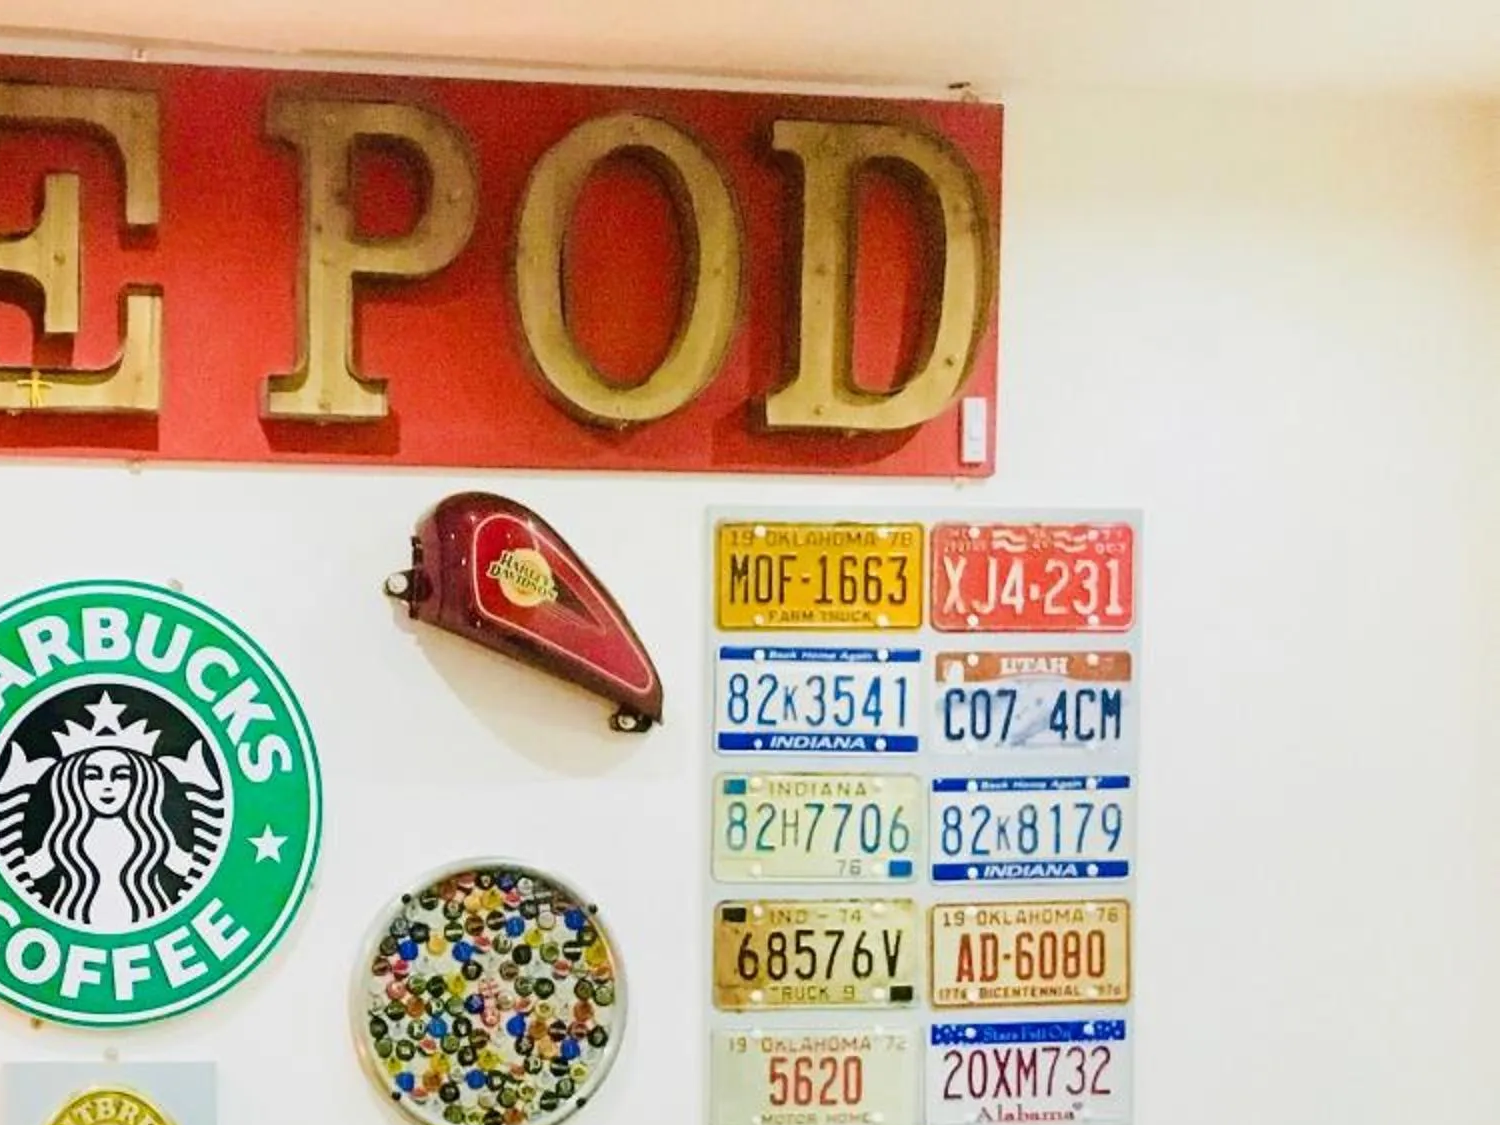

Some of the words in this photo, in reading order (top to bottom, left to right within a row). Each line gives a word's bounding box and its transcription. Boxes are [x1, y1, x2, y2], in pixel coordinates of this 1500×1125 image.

[259, 87, 991, 432] POD
[730, 530, 753, 547] 19
[766, 530, 876, 546] OKLAHOMA
[730, 554, 908, 606] MOF-1663
[769, 611, 814, 623] FARM
[821, 610, 871, 622] TRUCK
[1001, 656, 1069, 674] UTAH
[728, 673, 907, 727] 82K3541
[1050, 689, 1122, 740] 4CM
[770, 736, 866, 749] INDIANA
[768, 781, 868, 797] INDIANA
[727, 802, 909, 852] 82H7706
[942, 803, 1122, 855] 82K8179
[984, 864, 1077, 877] INDIANA
[769, 910, 809, 923] IND
[943, 913, 965, 927] 19
[977, 910, 1084, 925] OKLAHOMA
[737, 930, 903, 981] 68576V
[979, 986, 1078, 998] BICENTENNIAL
[761, 1036, 871, 1052] OKLAHOMA
[769, 1056, 863, 1106] 5620
[943, 1045, 1111, 1100] 20XM732
[761, 1114, 816, 1125] MOTOR
[826, 1113, 870, 1124] HOME
[976, 1103, 1075, 1124] Alabama
